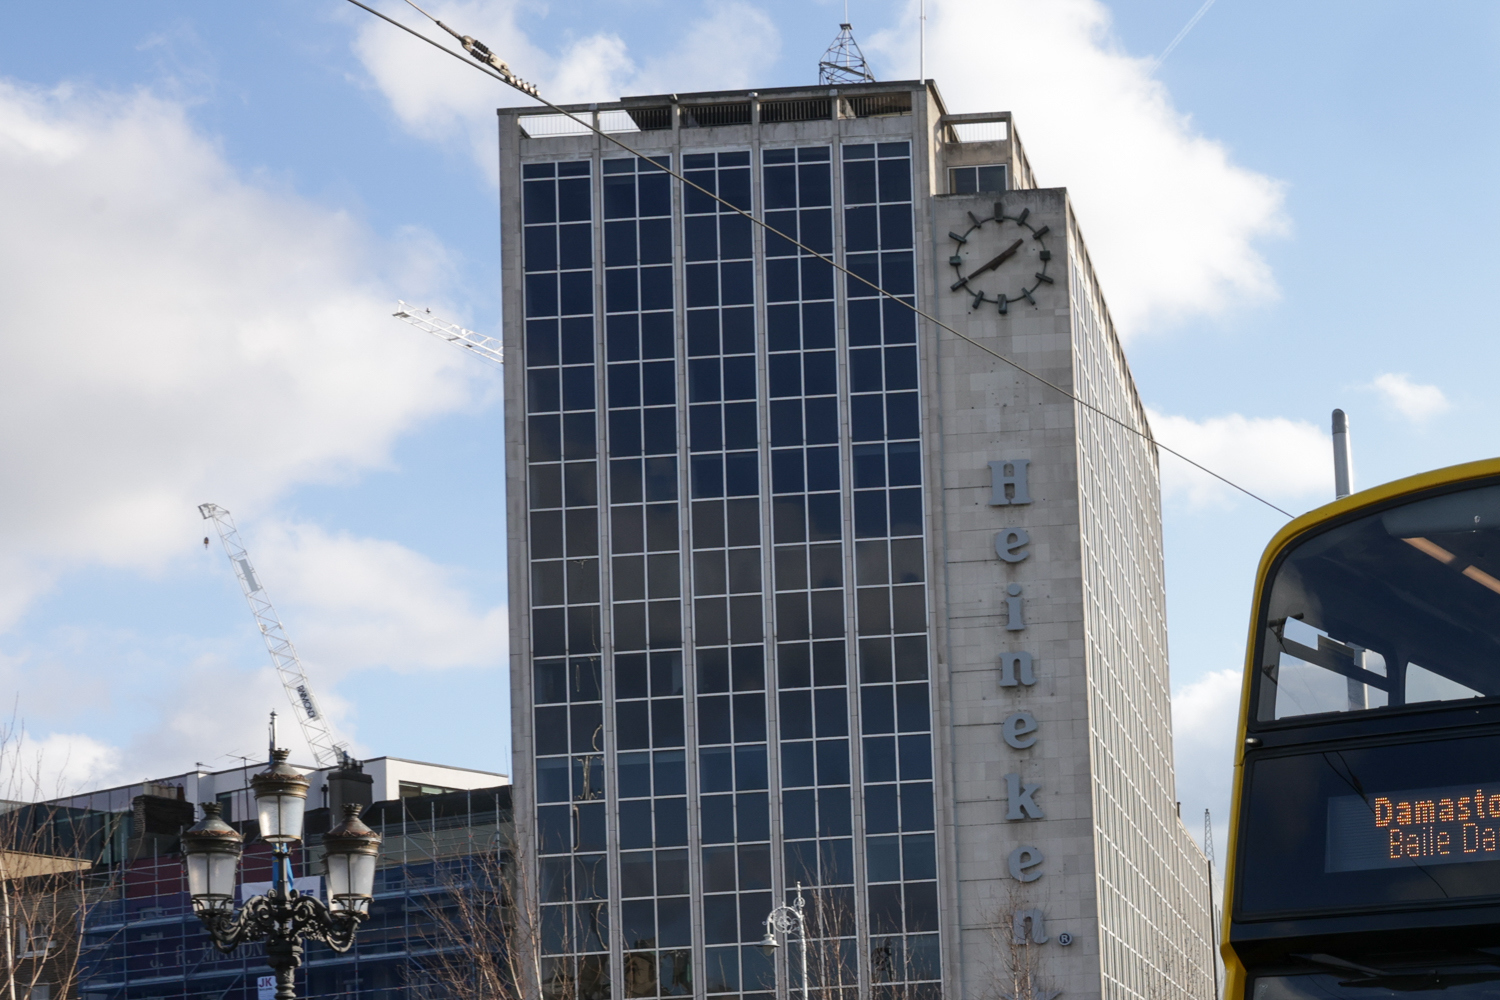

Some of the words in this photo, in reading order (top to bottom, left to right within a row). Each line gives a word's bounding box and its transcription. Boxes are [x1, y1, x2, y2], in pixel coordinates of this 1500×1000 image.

[987, 458, 1048, 946] Heineken
[1390, 825, 1450, 859] Baile
[259, 977, 273, 988] JK
